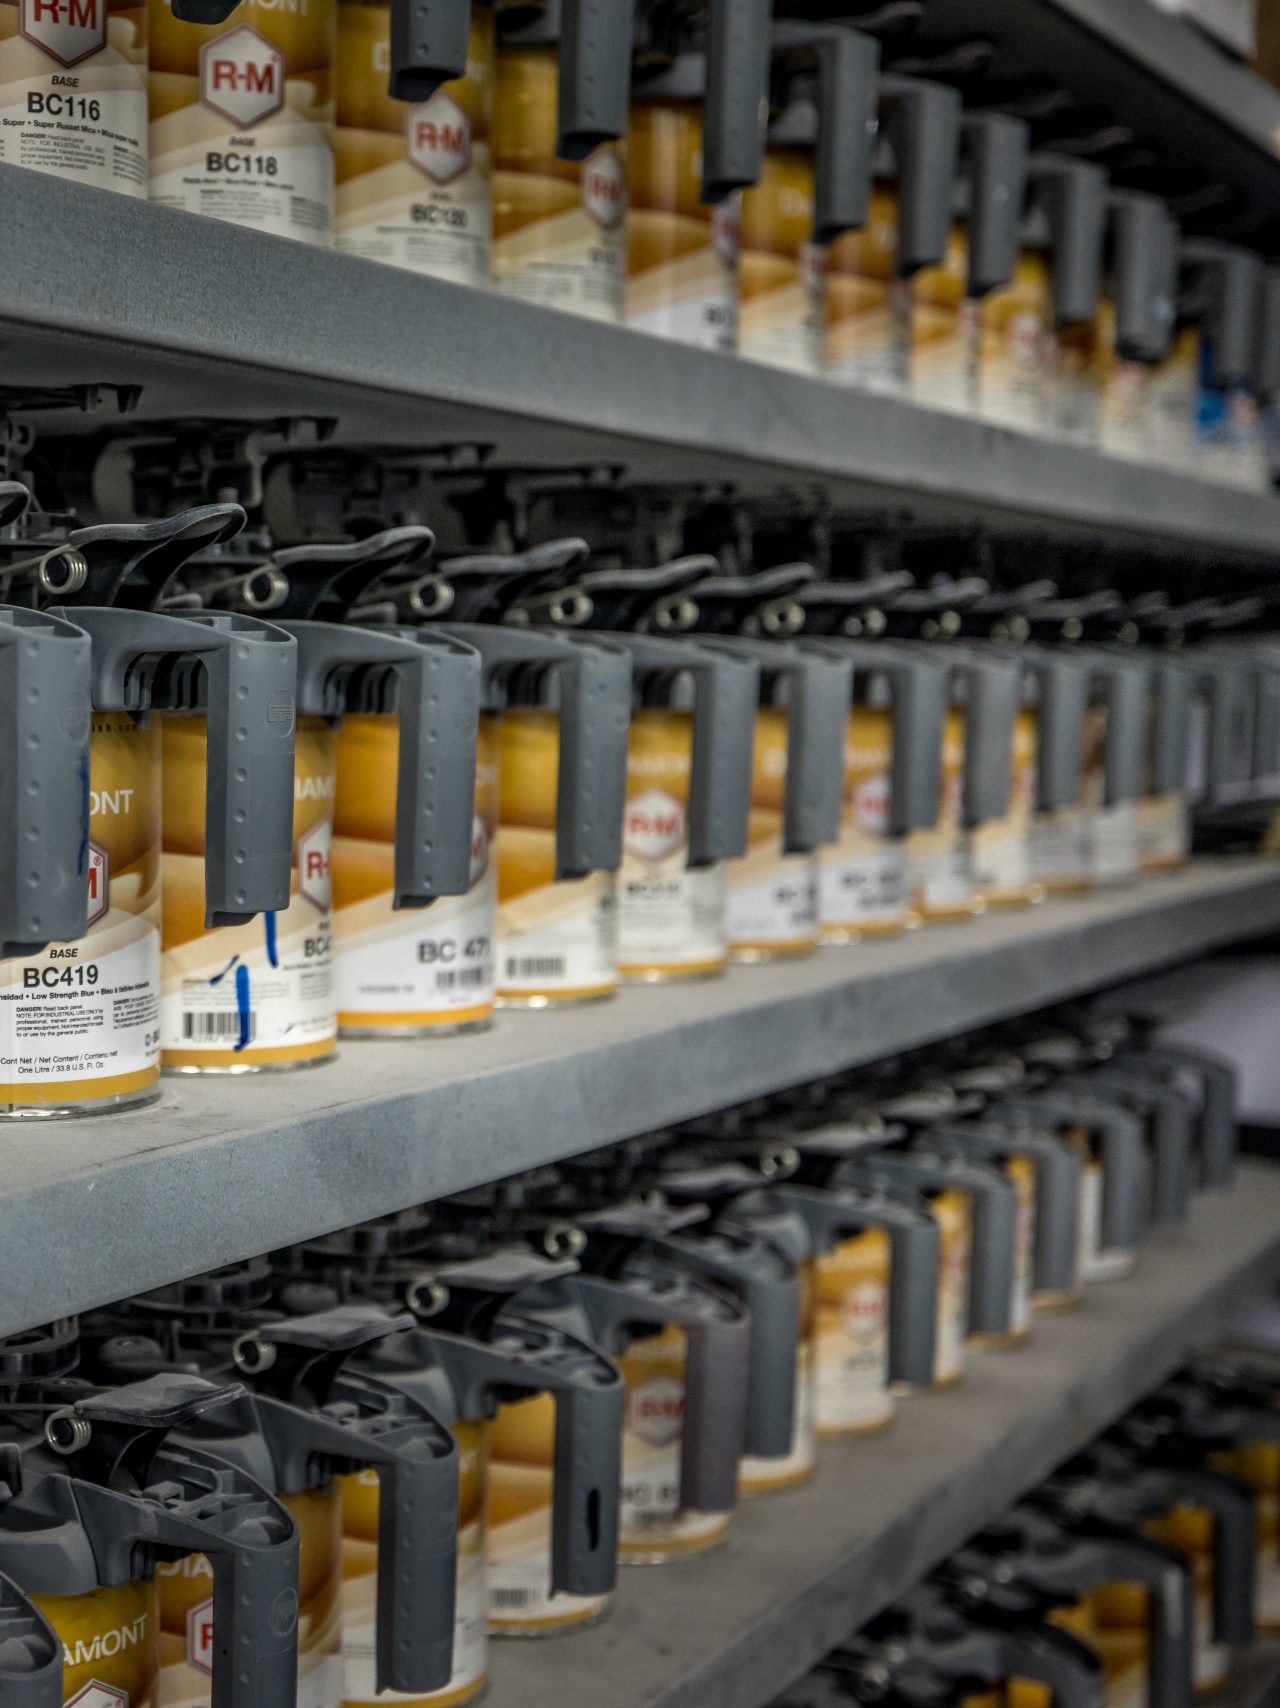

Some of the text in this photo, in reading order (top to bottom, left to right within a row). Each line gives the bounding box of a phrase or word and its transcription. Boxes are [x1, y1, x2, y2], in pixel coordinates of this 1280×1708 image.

[33, 0, 98, 30] R-M
[51, 75, 80, 88] BASE
[212, 60, 275, 94] R-M
[27, 92, 101, 121] BC116
[3, 118, 26, 127] Super
[33, 120, 55, 129] Super
[206, 151, 278, 177] BC118
[49, 948, 78, 959] BASE
[417, 937, 457, 964] BC
[23, 964, 99, 988] BC419
[49, 991, 79, 999] Strength
[0, 1057, 18, 1065] Cont
[52, 1055, 79, 1063] Content
[18, 1066, 33, 1074] One
[34, 1065, 50, 1073] Litre
[56, 1064, 71, 1072] 33.8
